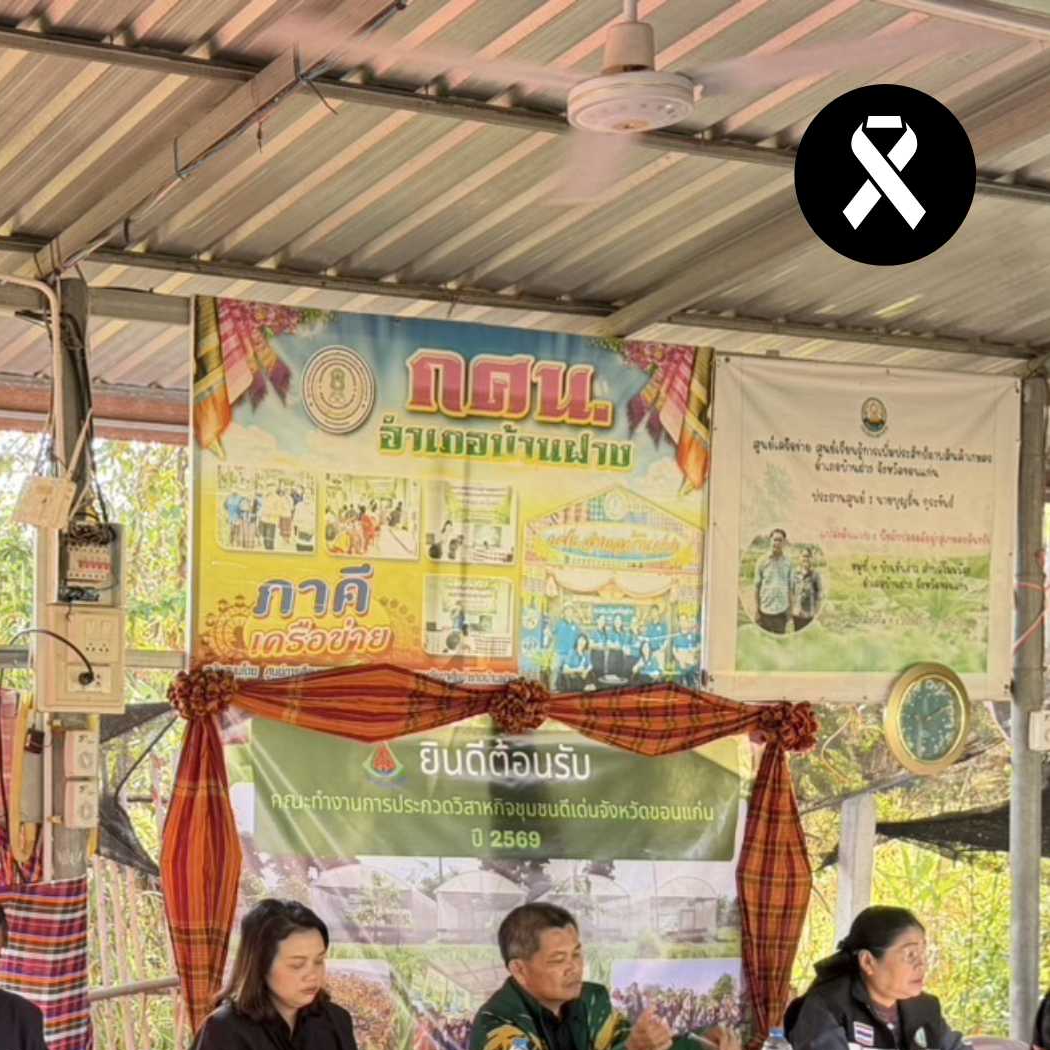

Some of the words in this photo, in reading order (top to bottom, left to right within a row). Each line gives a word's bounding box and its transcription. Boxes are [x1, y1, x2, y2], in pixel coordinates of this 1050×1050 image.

[379, 415, 635, 471] อำเภอบ้านฝาง
[253, 563, 373, 619] ภาคี
[248, 616, 394, 659] เครือข่าย
[419, 739, 592, 782] ยินดีต้อนรับ
[490, 828, 541, 849] 2569
